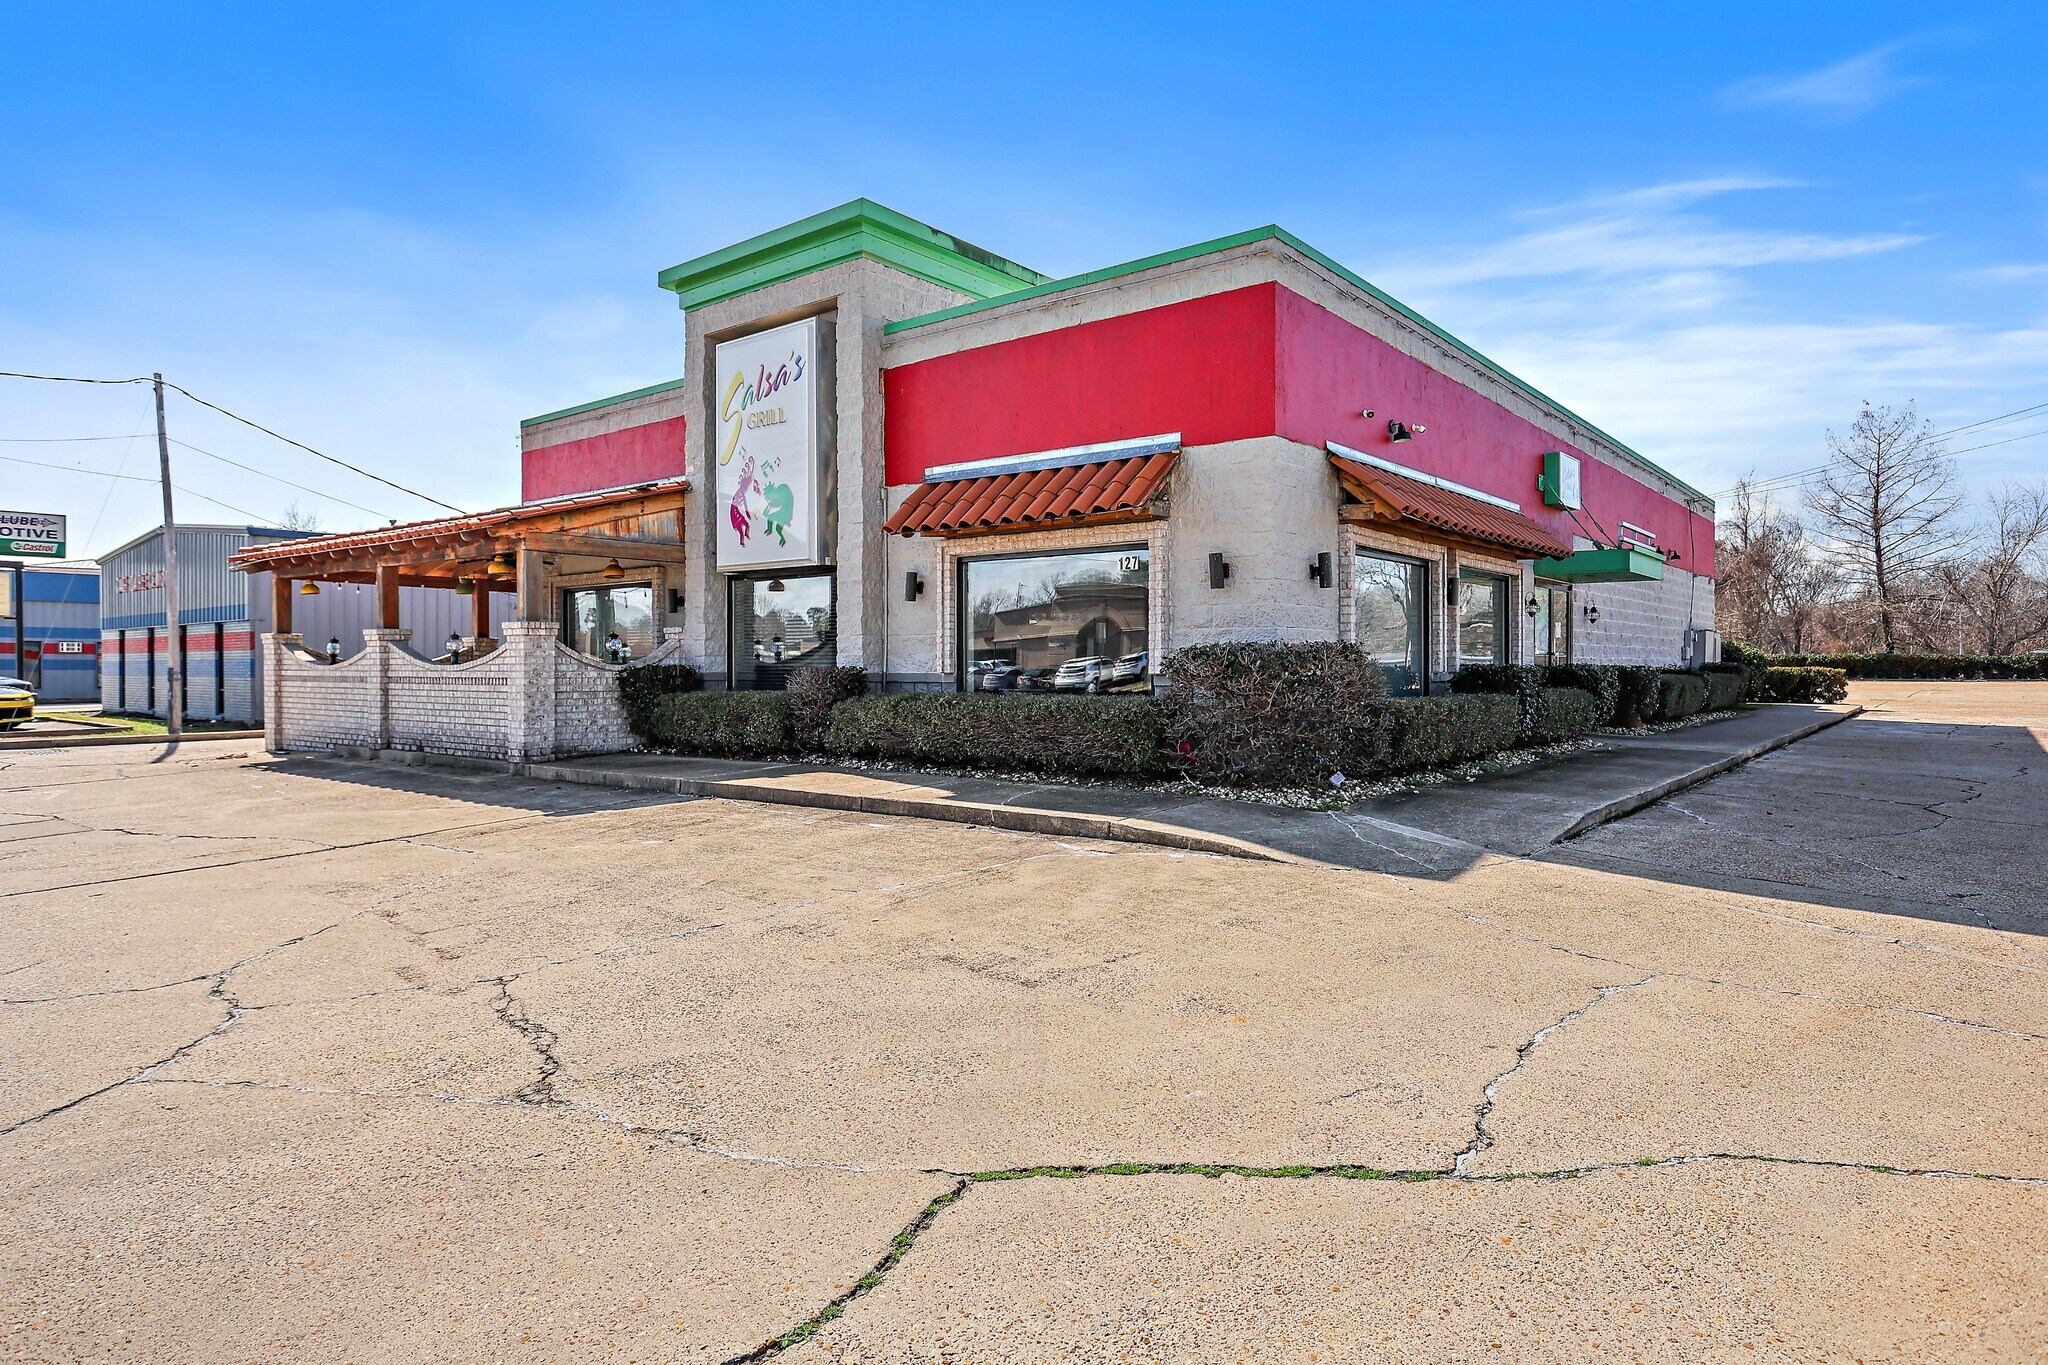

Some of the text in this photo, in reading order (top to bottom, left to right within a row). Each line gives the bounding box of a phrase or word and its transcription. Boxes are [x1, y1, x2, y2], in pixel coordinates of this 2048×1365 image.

[720, 350, 806, 466] Salsa's
[747, 407, 787, 430] GRILL
[1, 515, 39, 526] LUBE
[22, 543, 54, 552] Castrol
[1118, 556, 1138, 570] 127
